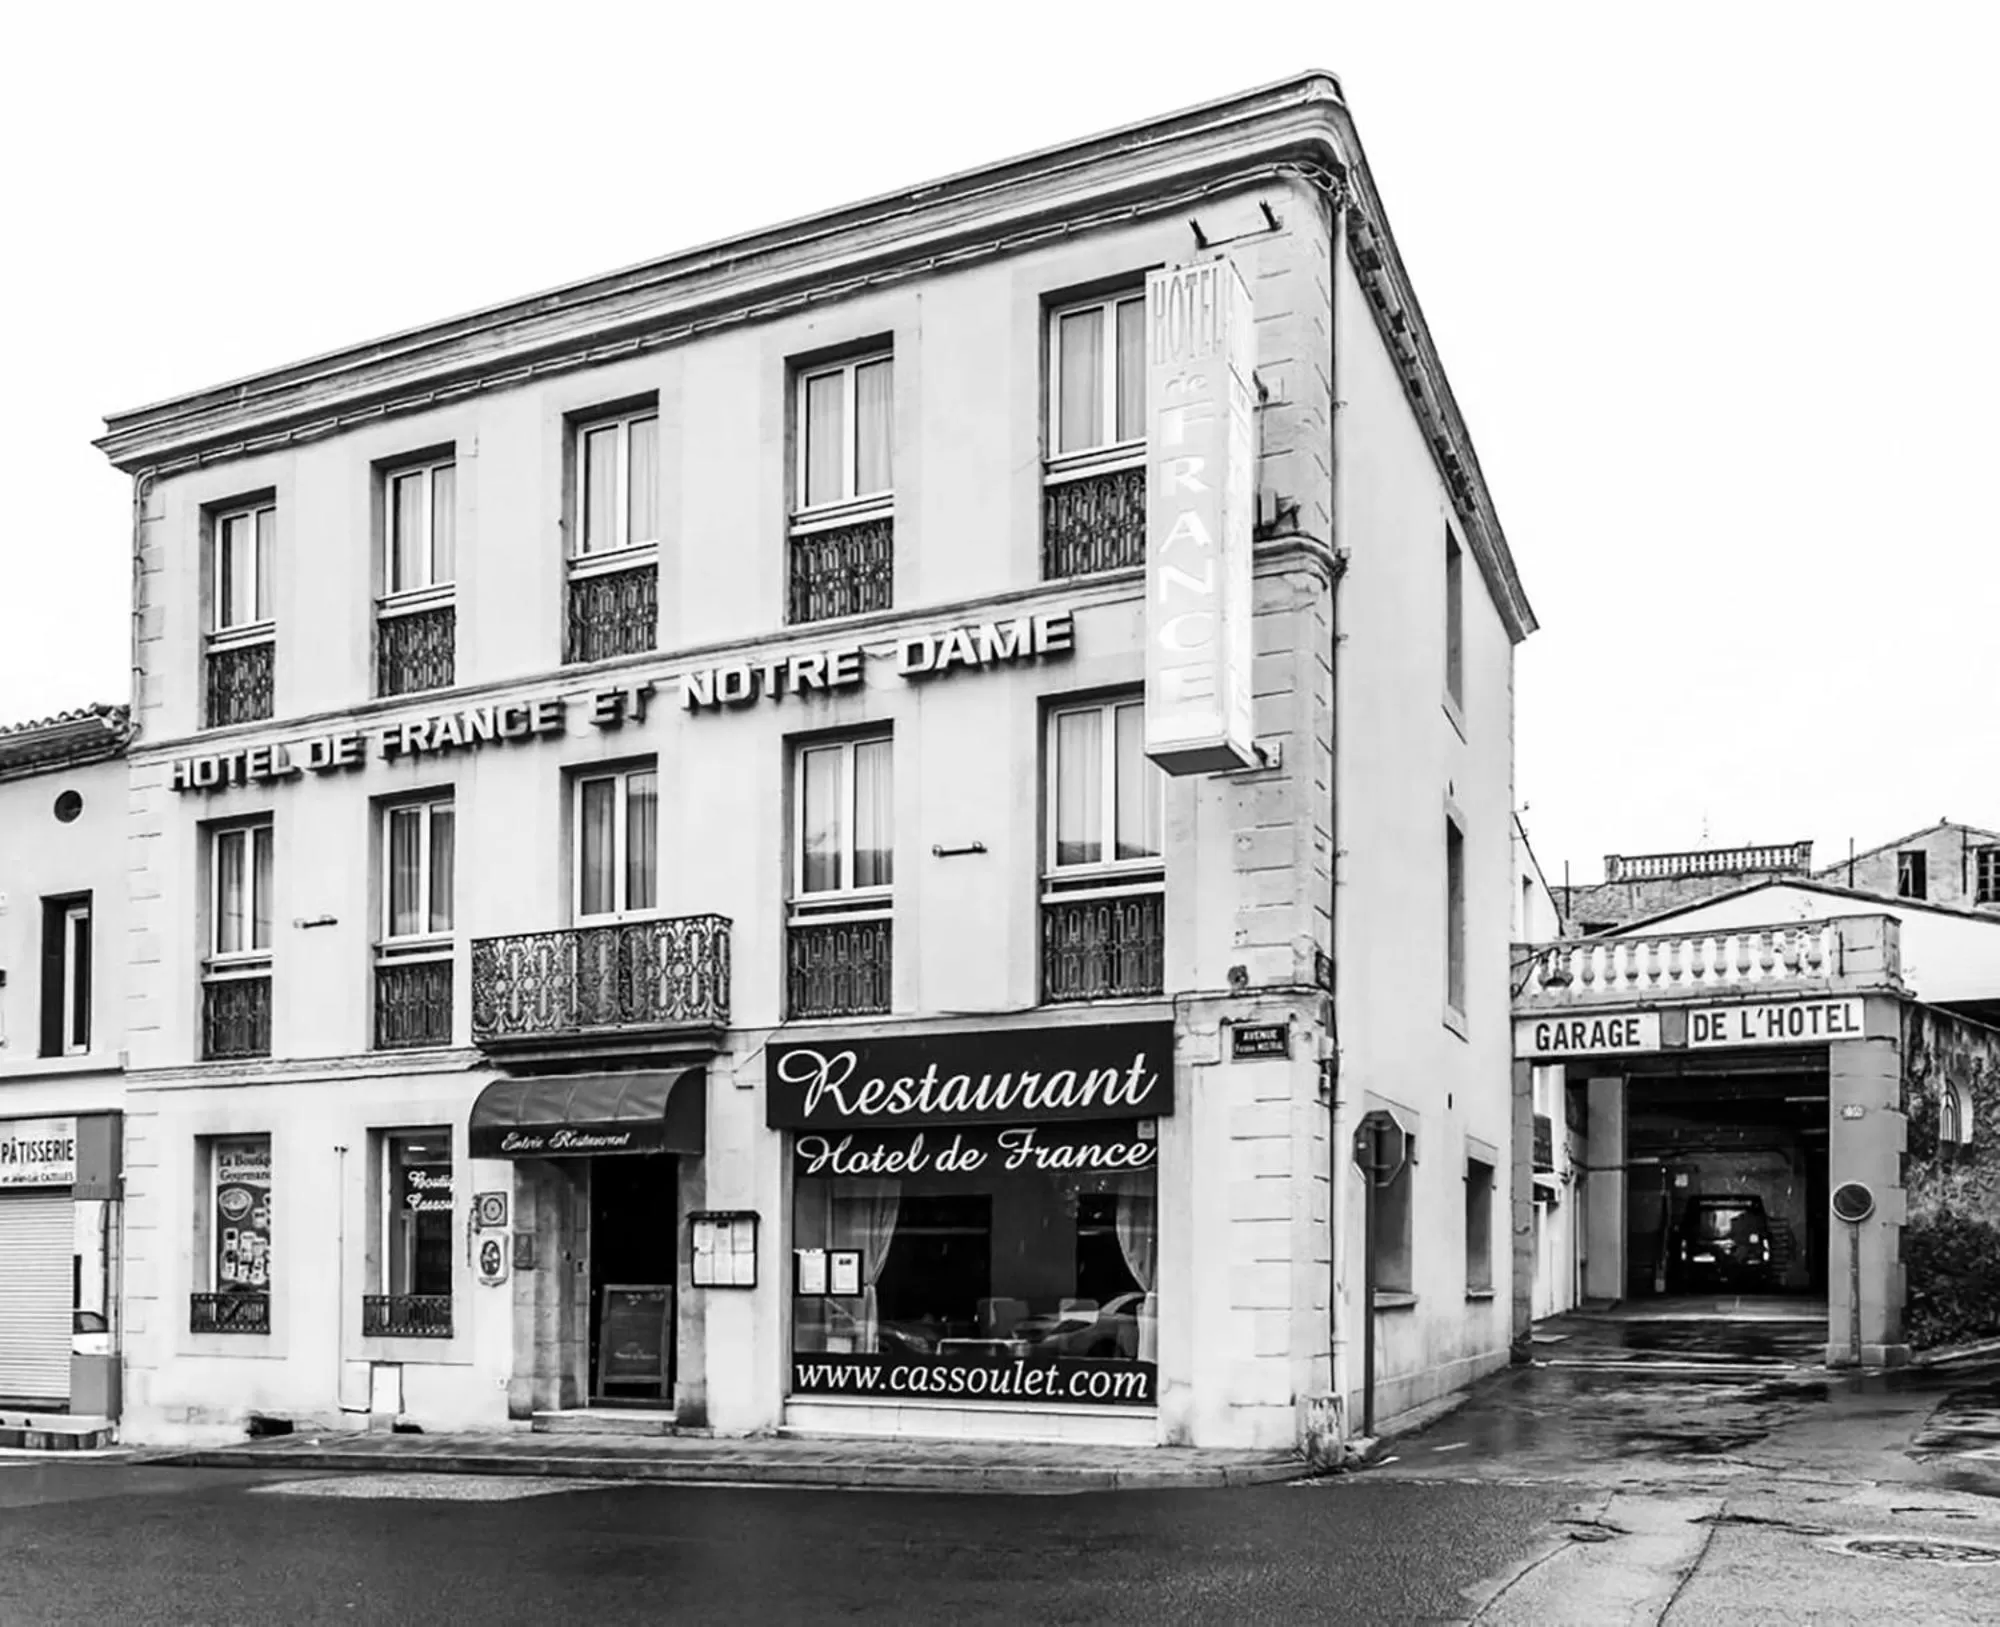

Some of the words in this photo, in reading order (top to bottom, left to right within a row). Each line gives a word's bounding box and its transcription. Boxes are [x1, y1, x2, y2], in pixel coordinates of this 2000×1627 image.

[1152, 266, 1222, 364] HOTEL
[1157, 398, 1216, 704] FRANCE
[169, 743, 297, 791] HOTEL
[304, 733, 363, 771] DE
[377, 698, 563, 759] FRANCE
[588, 681, 655, 724] ET
[679, 646, 864, 711] NOTRE
[898, 611, 1074, 676] DAME
[1243, 1029, 1278, 1041] AVENUE
[1535, 1018, 1641, 1051] GARAGE
[1693, 1012, 1727, 1042] DE
[1741, 1003, 1860, 1039] L'HOTEL
[777, 1049, 1158, 1118] Restaurant
[1, 1136, 75, 1164] PÂTISSERIE
[550, 1129, 631, 1148] Restaurant
[796, 1133, 930, 1175] Hotel
[935, 1134, 988, 1173] de
[998, 1128, 1157, 1171] France
[797, 1361, 1149, 1398] www.cassoulet.com
